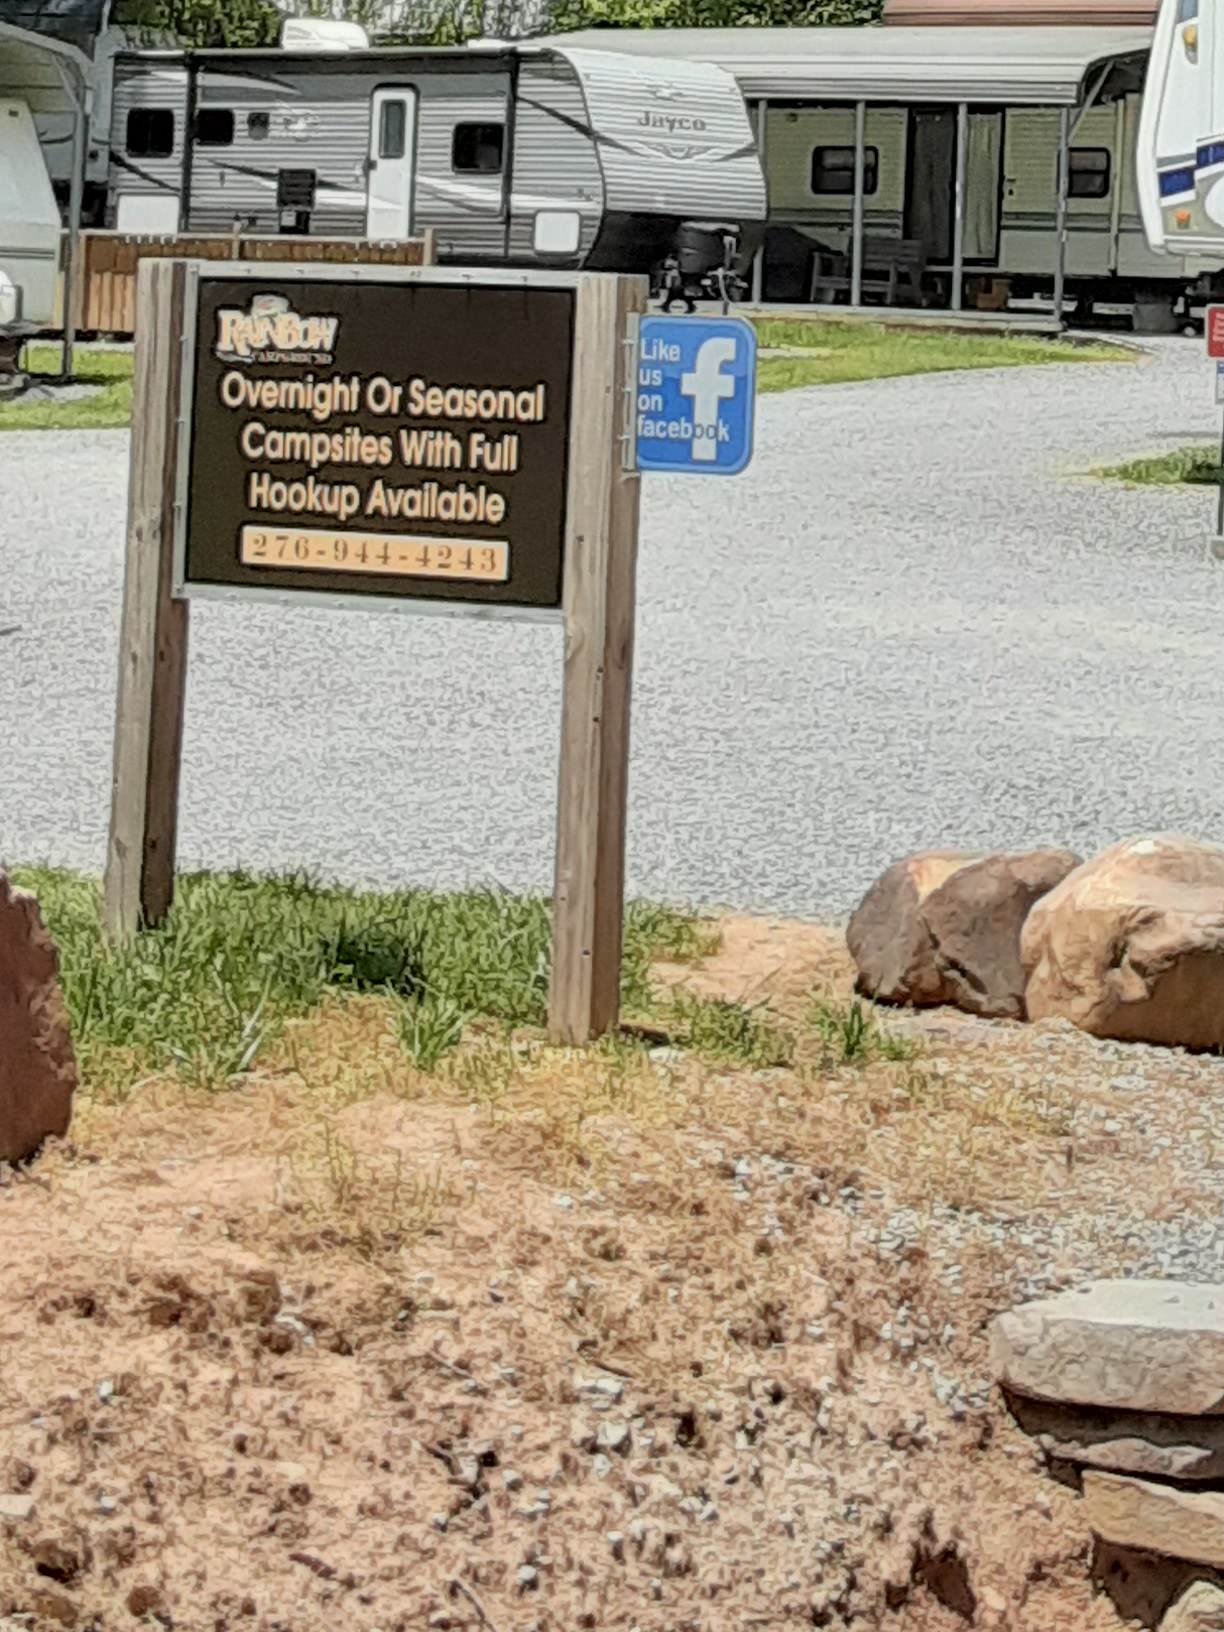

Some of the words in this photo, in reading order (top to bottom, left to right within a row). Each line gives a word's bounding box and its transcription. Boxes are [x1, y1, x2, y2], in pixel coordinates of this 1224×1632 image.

[640, 338, 681, 362] Like
[639, 368, 663, 386] us
[221, 371, 360, 420] Overnight
[366, 377, 402, 414] Or
[408, 378, 546, 421] Seasonal
[638, 393, 663, 412] on
[637, 415, 730, 442] facebook
[241, 423, 393, 467] Campsites
[400, 429, 462, 468] With
[469, 433, 519, 471] Full
[250, 472, 360, 520] Hookup
[366, 479, 505, 523] Available
[253, 533, 496, 573] 276-944-4243
